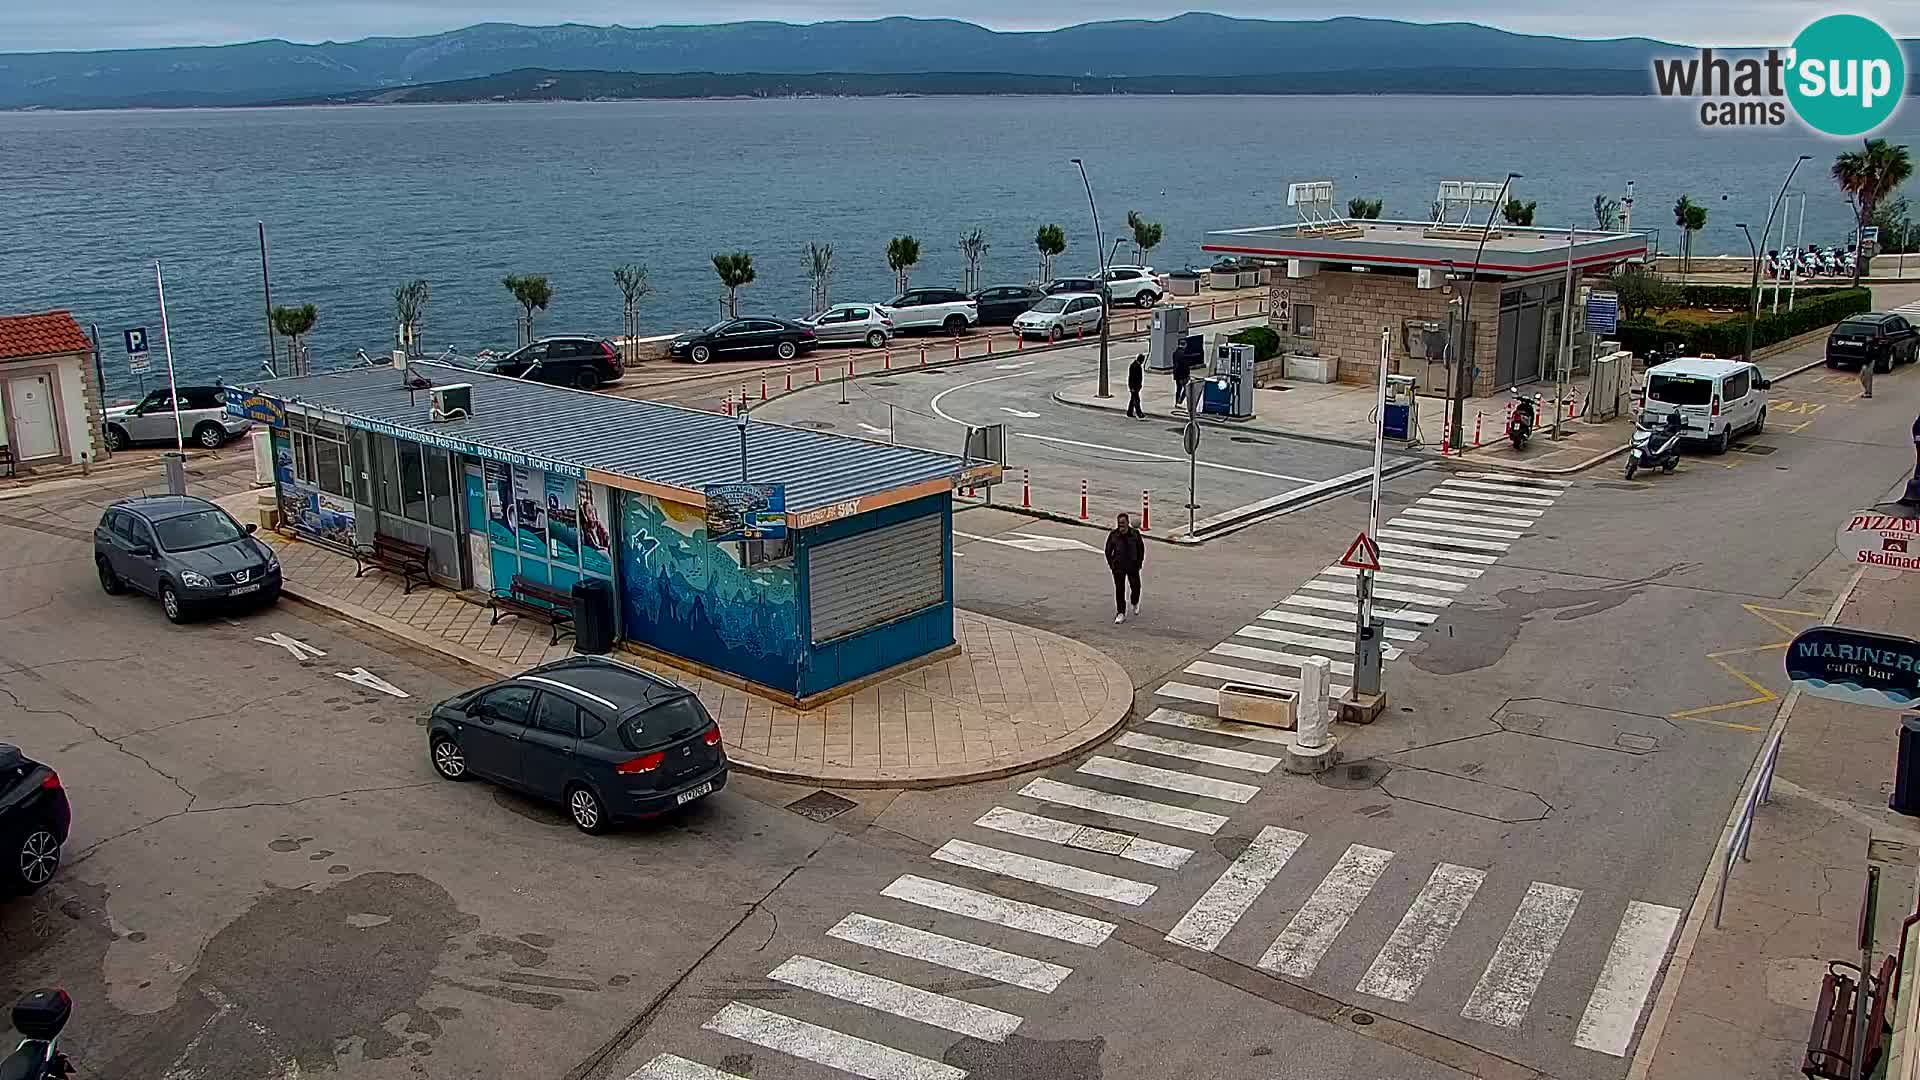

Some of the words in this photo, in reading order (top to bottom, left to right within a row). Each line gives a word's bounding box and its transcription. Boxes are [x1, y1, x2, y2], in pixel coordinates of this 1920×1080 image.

[436, 436, 468, 452] POSTAJA
[477, 447, 492, 458] BUS
[493, 449, 525, 465] STATION
[527, 457, 553, 471] TICKET
[554, 463, 581, 477] OFFICE
[1879, 530, 1915, 541] GRILL
[1826, 662, 1863, 675] caffe
[1868, 665, 1895, 680] bar
